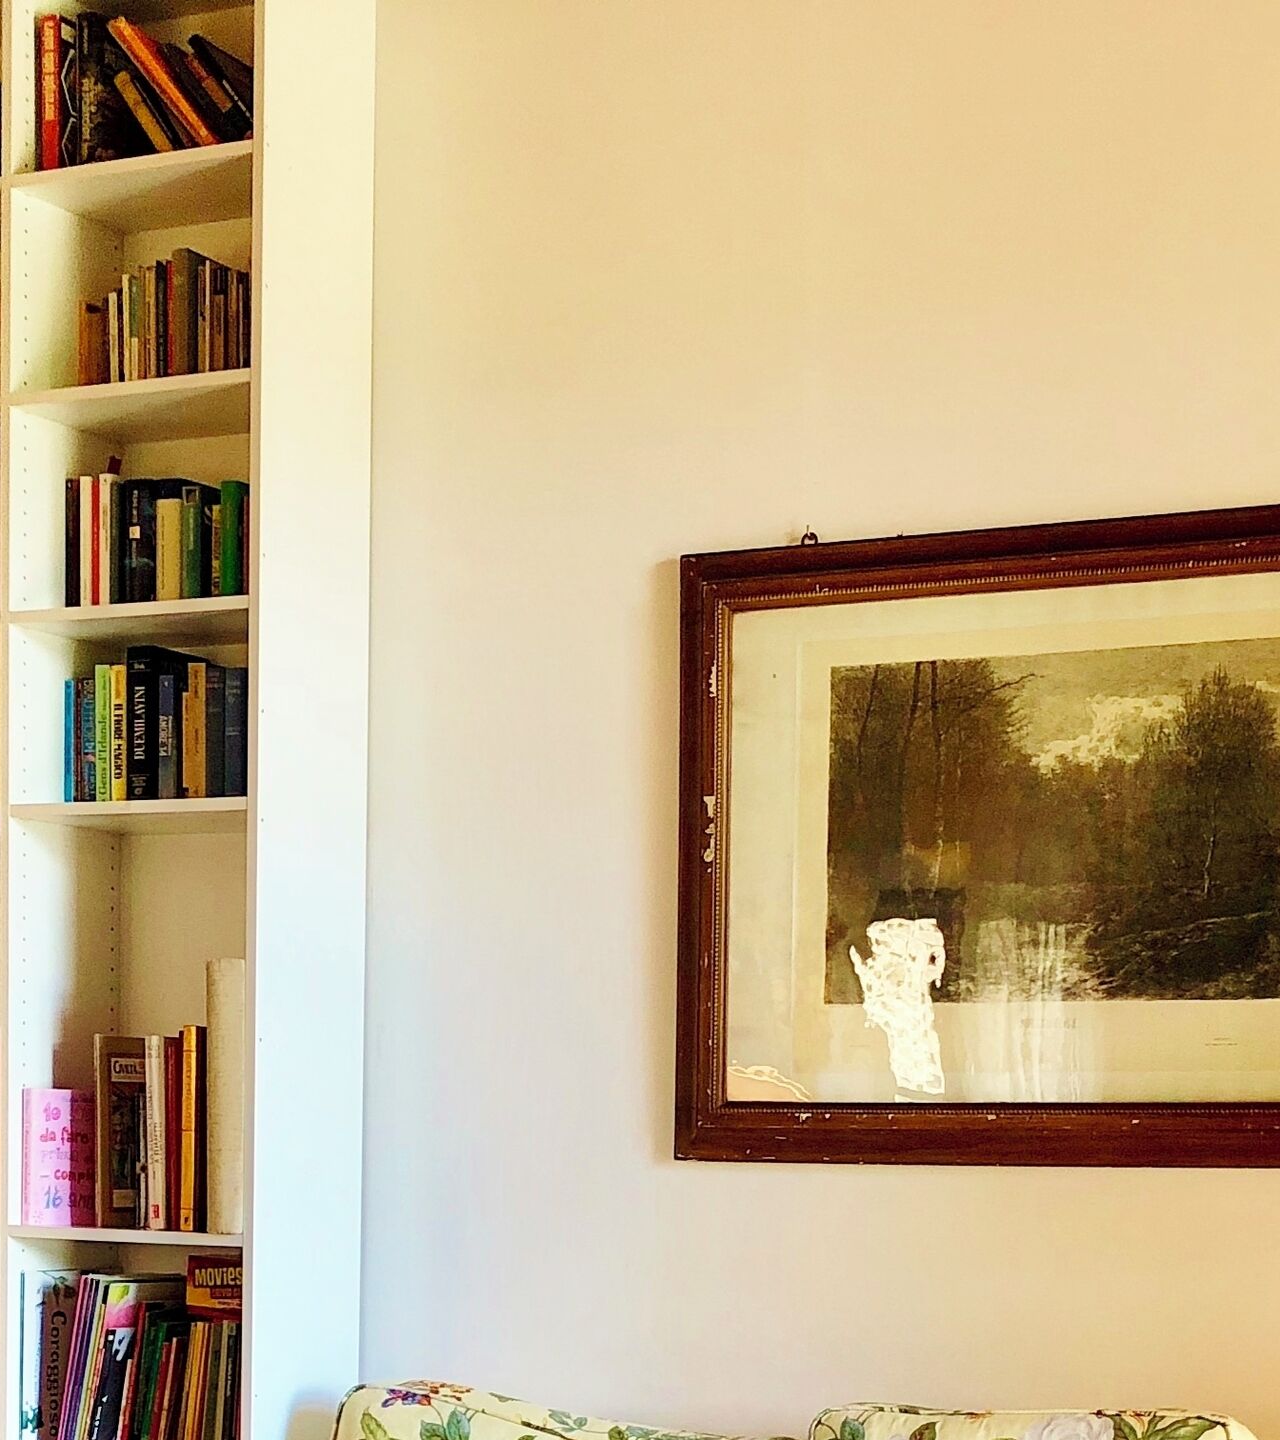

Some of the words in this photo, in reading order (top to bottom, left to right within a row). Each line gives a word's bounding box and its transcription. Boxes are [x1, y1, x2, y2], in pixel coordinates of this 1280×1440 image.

[133, 685, 146, 761] DUEMILAVINI
[39, 1127, 57, 1143] da
[43, 1185, 65, 1209] 16
[46, 1310, 68, 1438] Coraggioso
